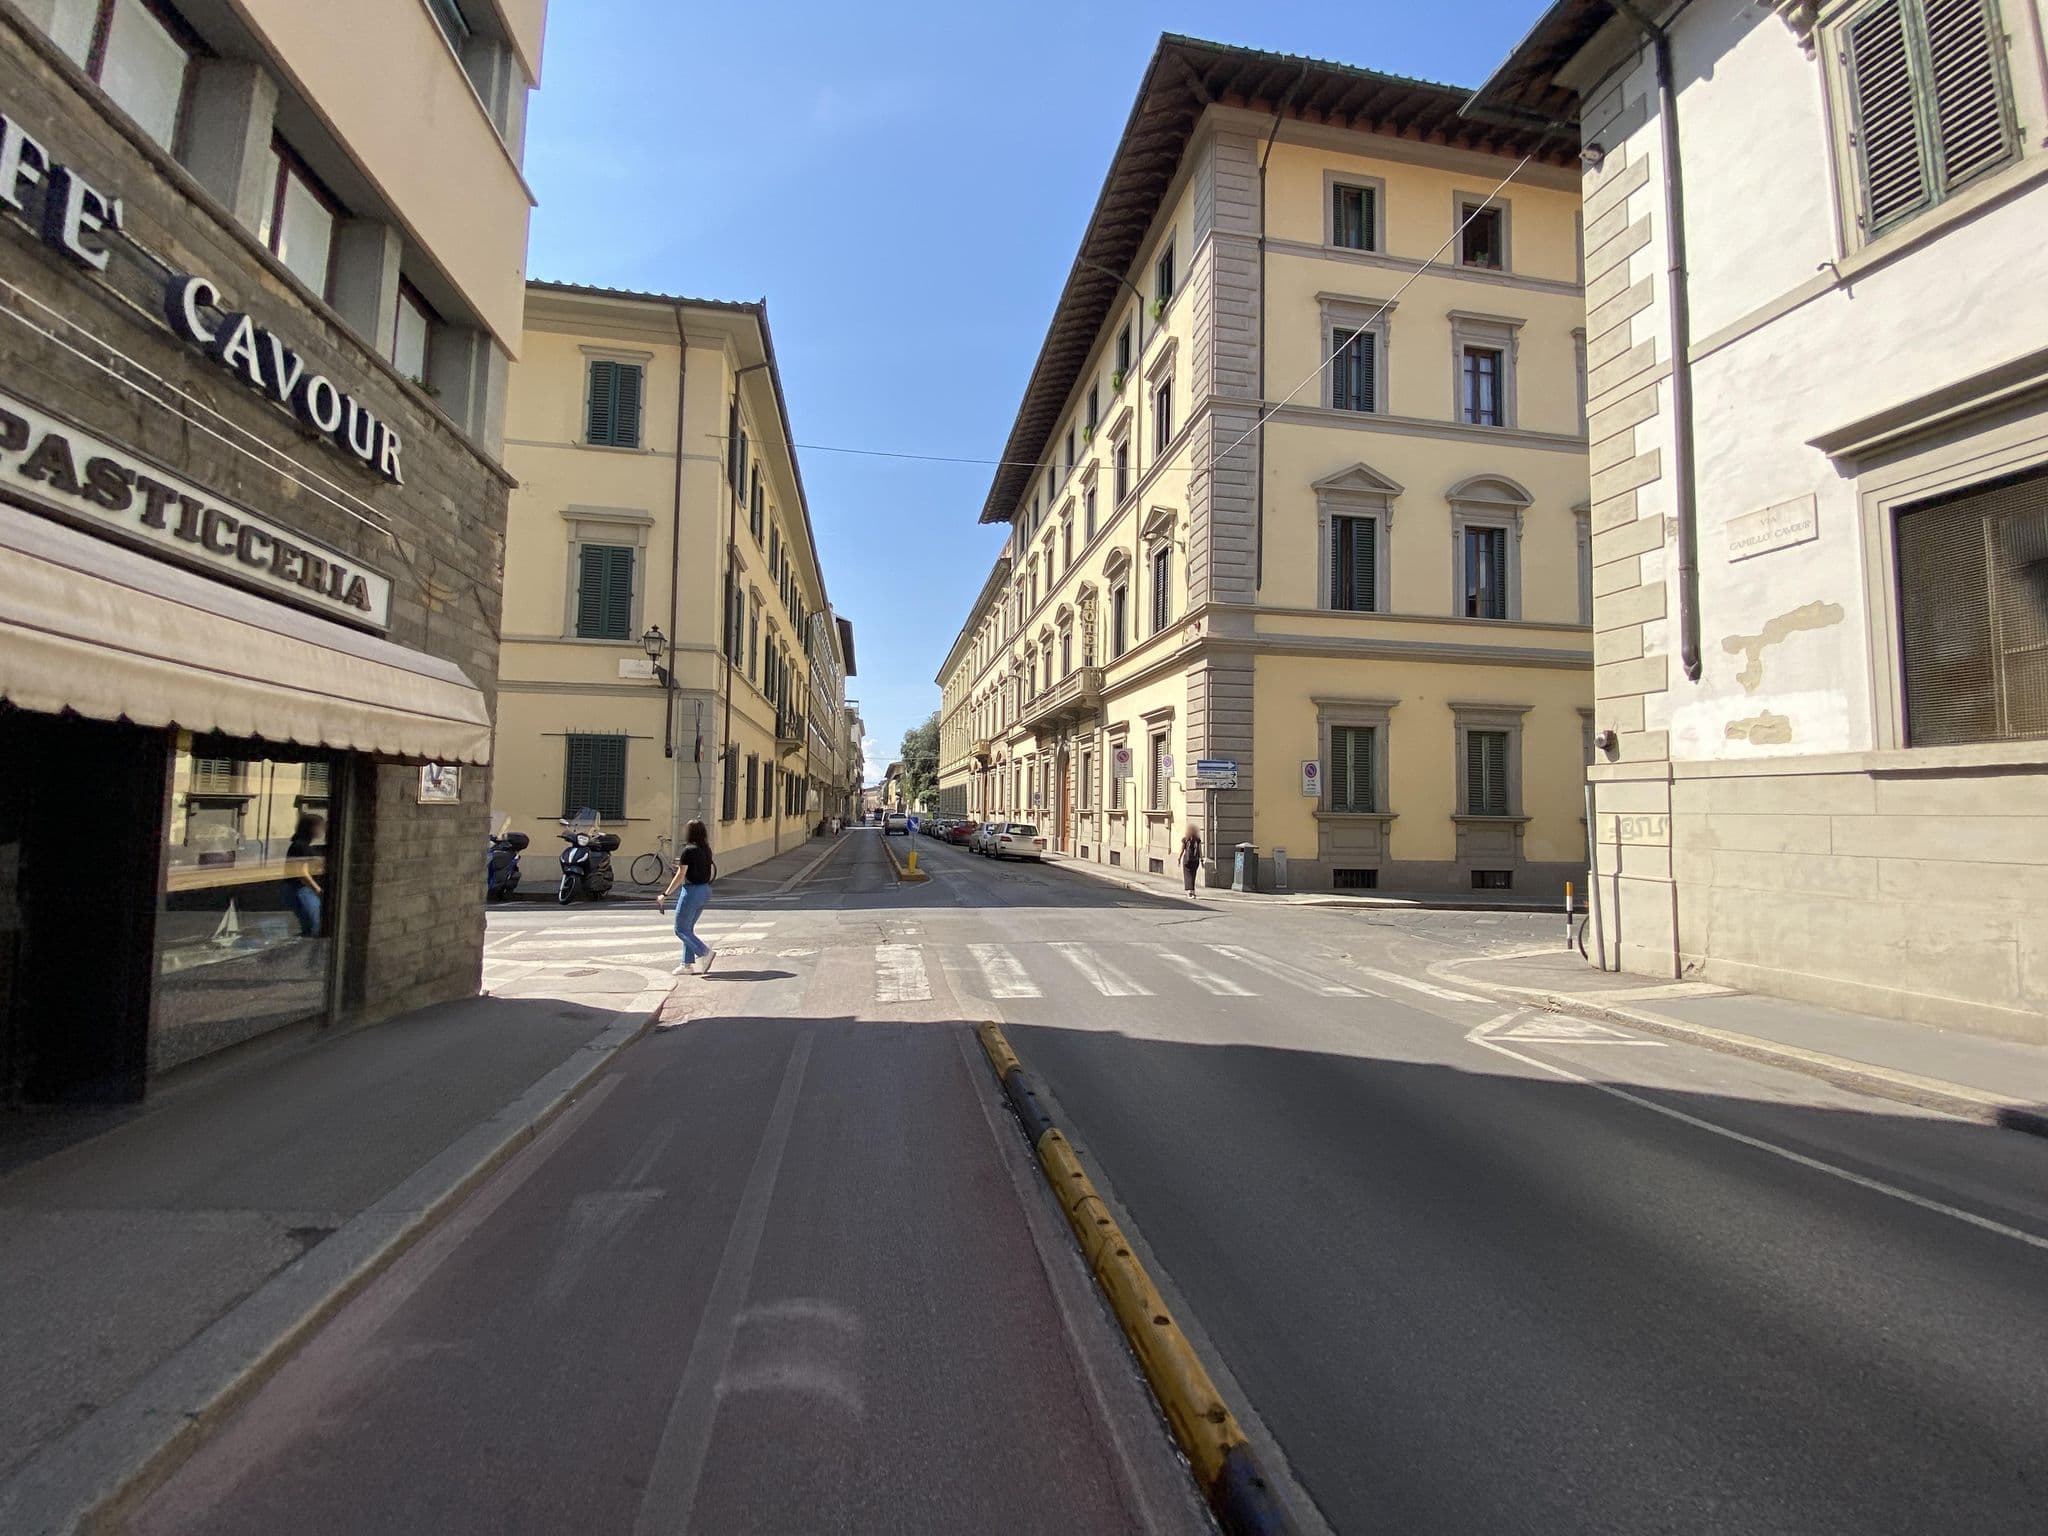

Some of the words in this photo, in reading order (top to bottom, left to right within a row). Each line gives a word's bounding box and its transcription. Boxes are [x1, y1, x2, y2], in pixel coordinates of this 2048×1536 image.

[180, 276, 405, 485] CAVOUR
[1729, 533, 1771, 551] CAMILLO
[1774, 519, 1812, 538] CAVOUR
[1760, 516, 1777, 526] VIA
